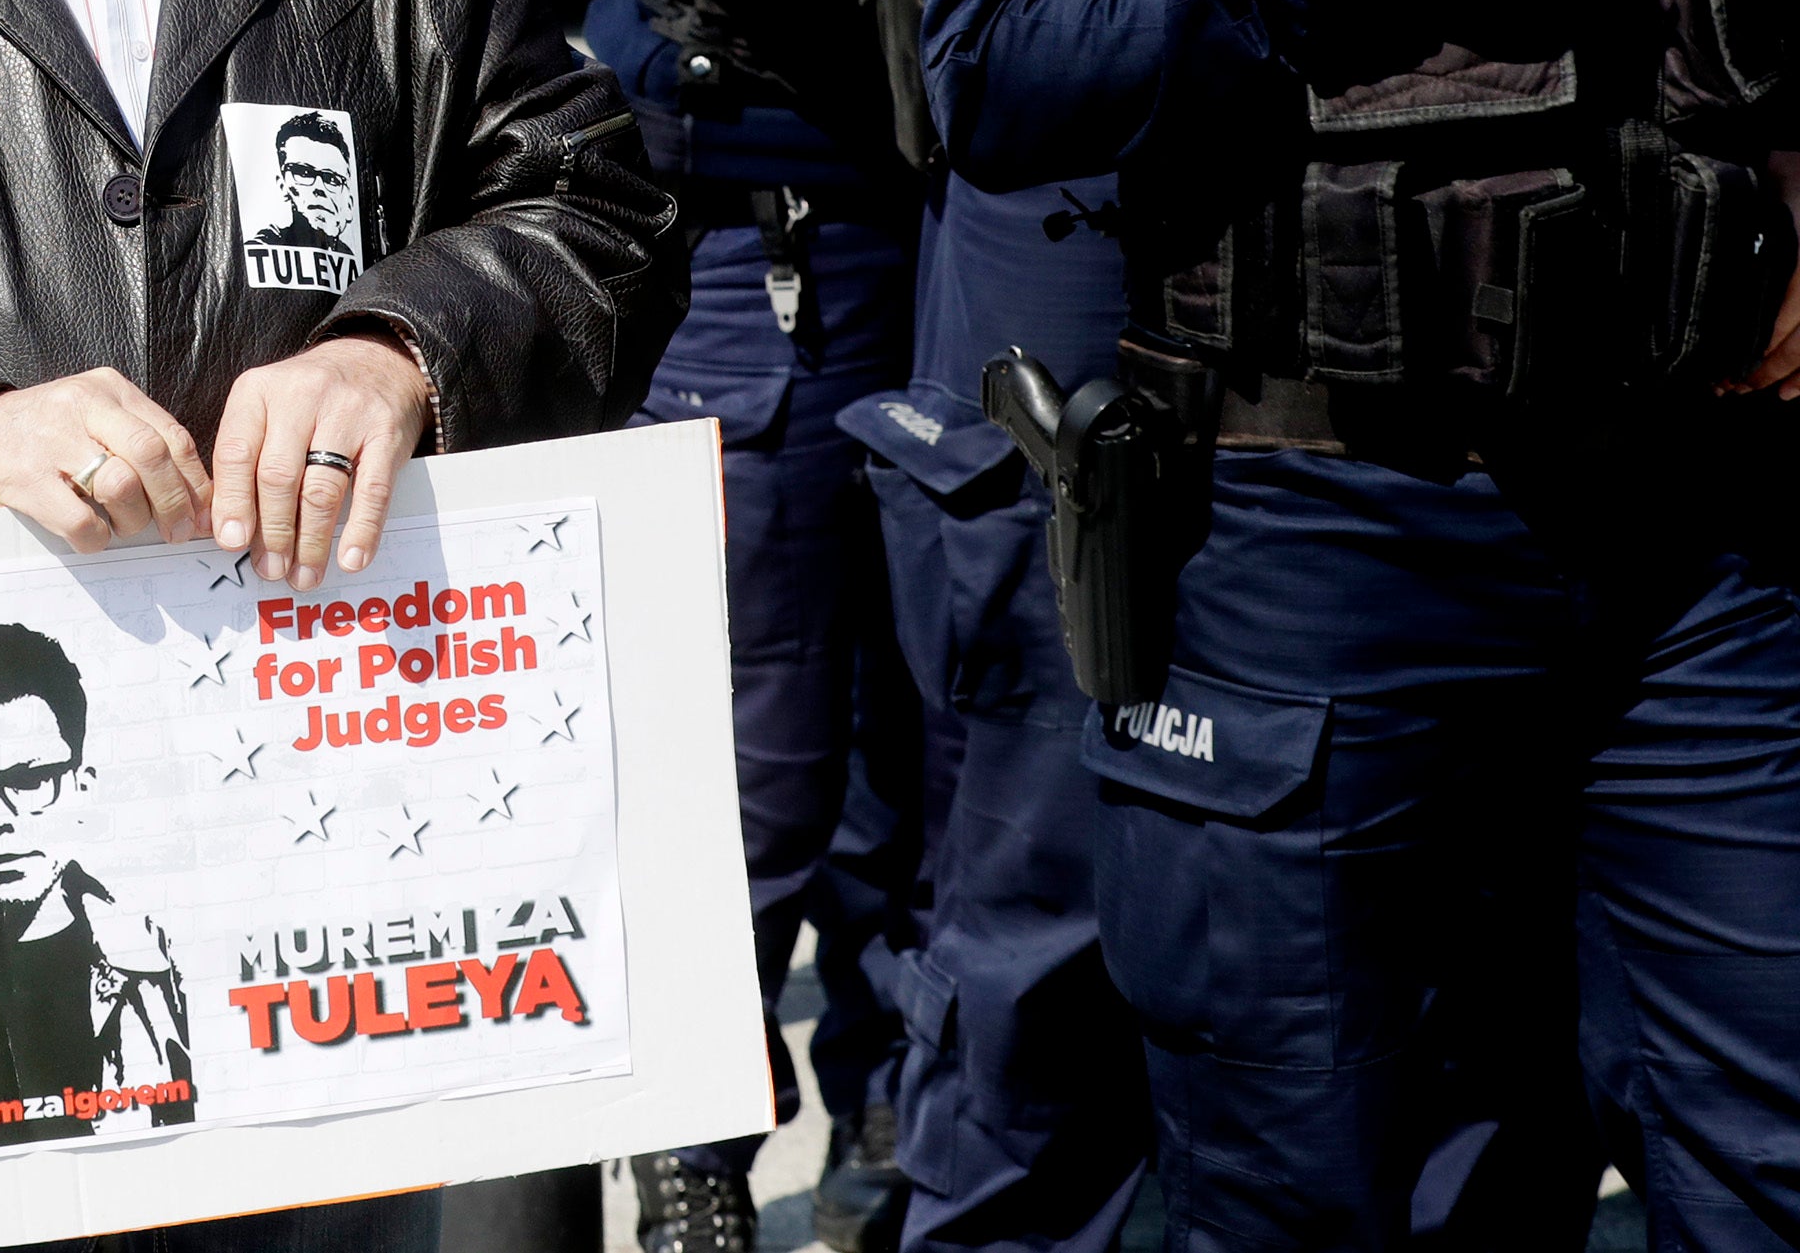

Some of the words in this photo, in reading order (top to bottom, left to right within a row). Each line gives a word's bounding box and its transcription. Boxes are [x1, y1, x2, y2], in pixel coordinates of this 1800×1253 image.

[257, 581, 527, 644] Freedom
[253, 653, 342, 700] for
[358, 626, 537, 689] Polish
[292, 694, 508, 752] Judges
[1114, 701, 1215, 763] POLICJA
[227, 905, 478, 982] MUREM
[484, 891, 586, 951] ZA
